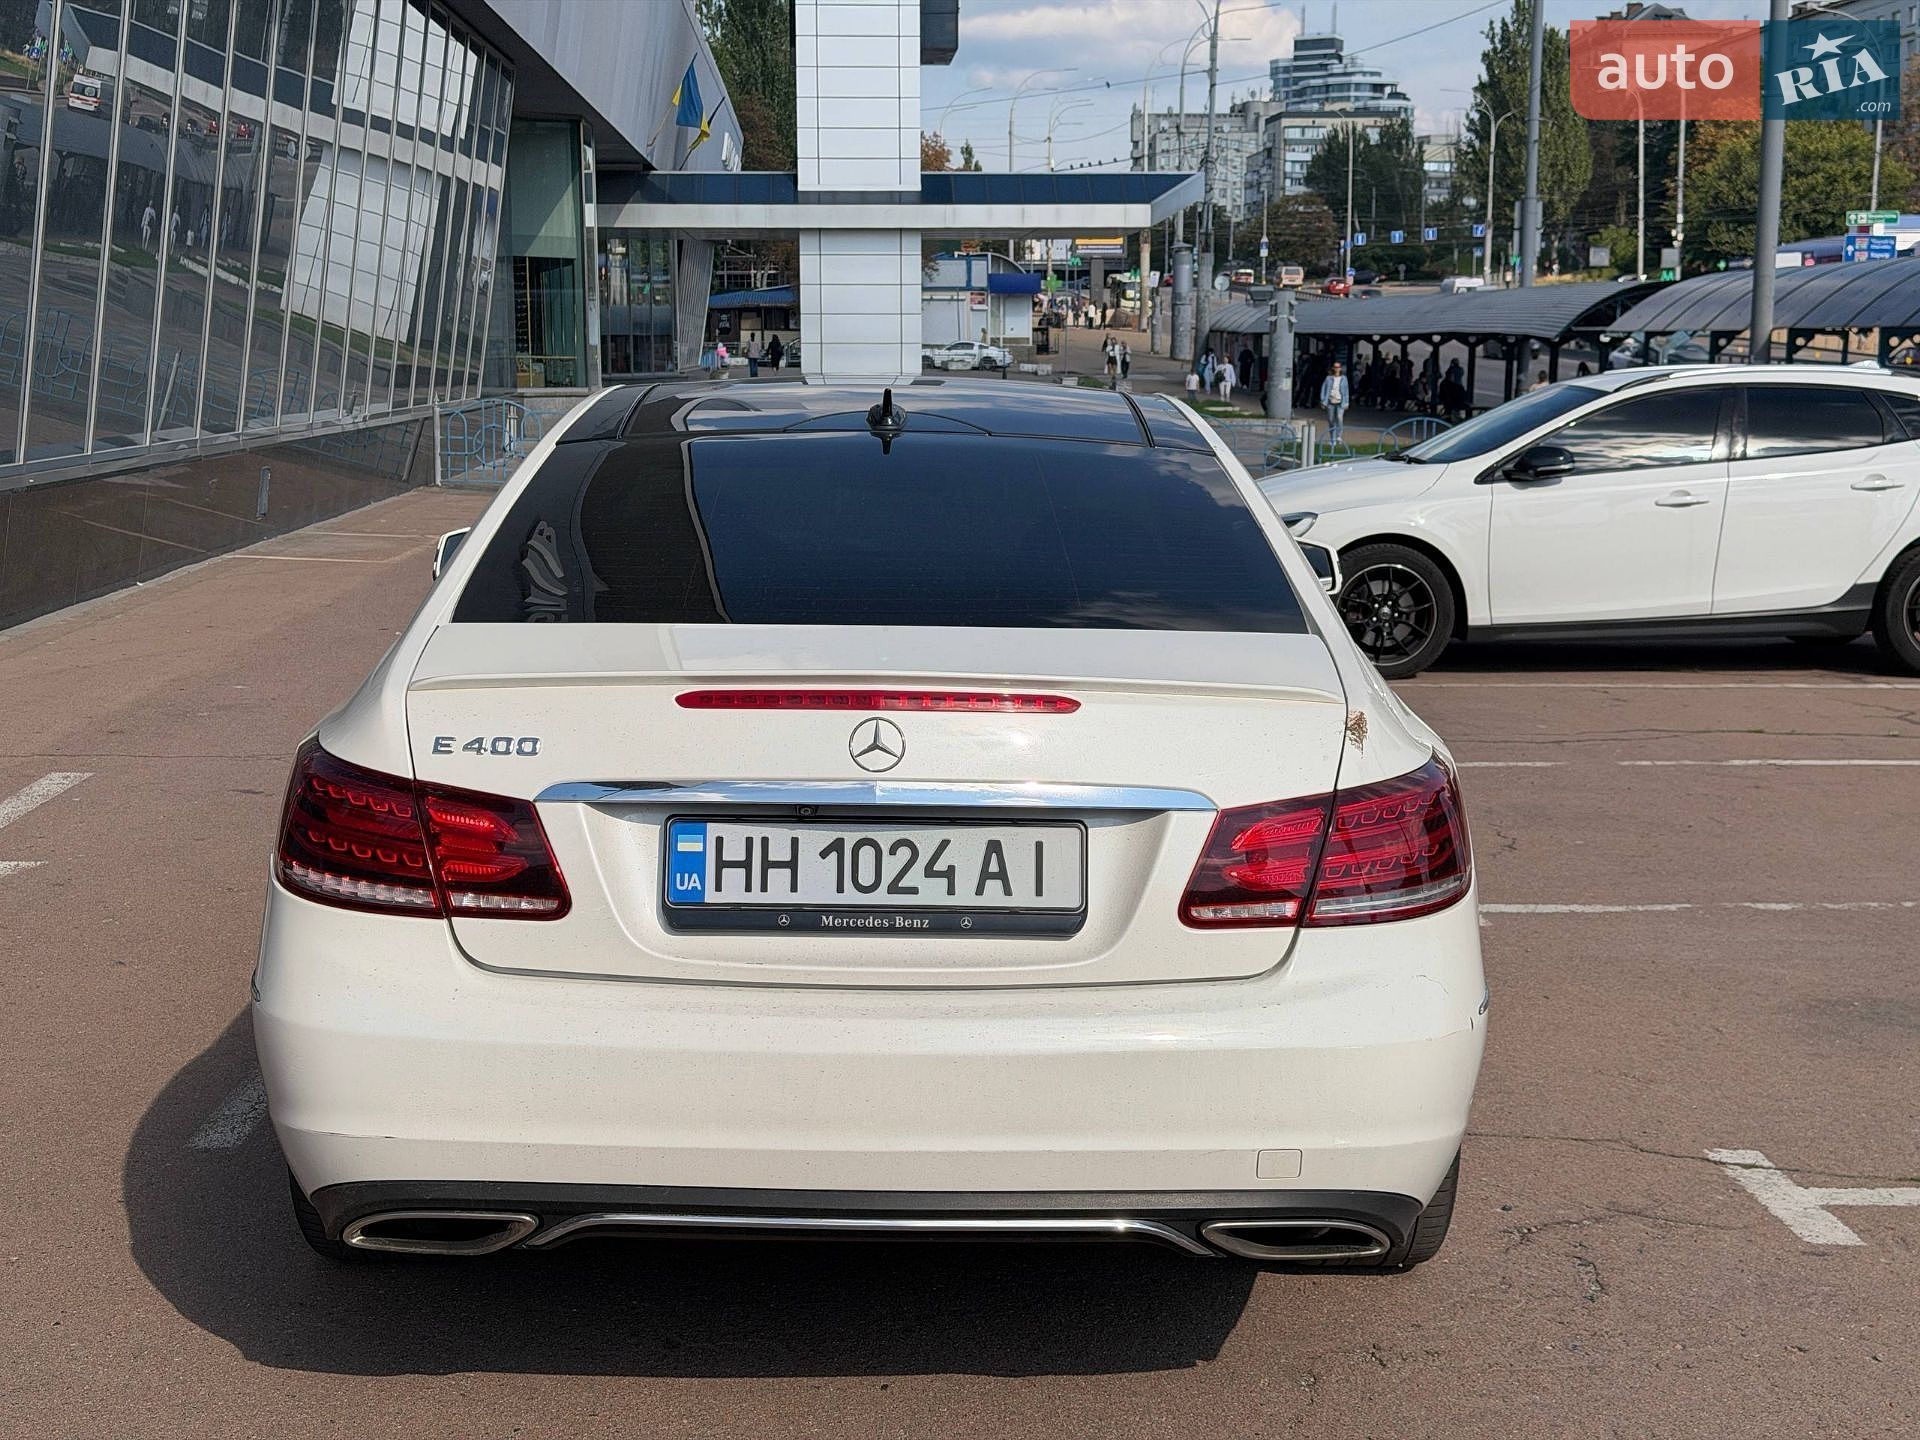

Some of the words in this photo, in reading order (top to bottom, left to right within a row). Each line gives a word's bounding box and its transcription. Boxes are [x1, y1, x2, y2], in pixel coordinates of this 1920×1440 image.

[432, 736, 456, 755] E
[461, 736, 541, 756] 400
[714, 836, 799, 893] HH
[818, 837, 956, 896] 1024
[676, 872, 702, 891] UA
[820, 915, 930, 929] Mercedes-Benz
